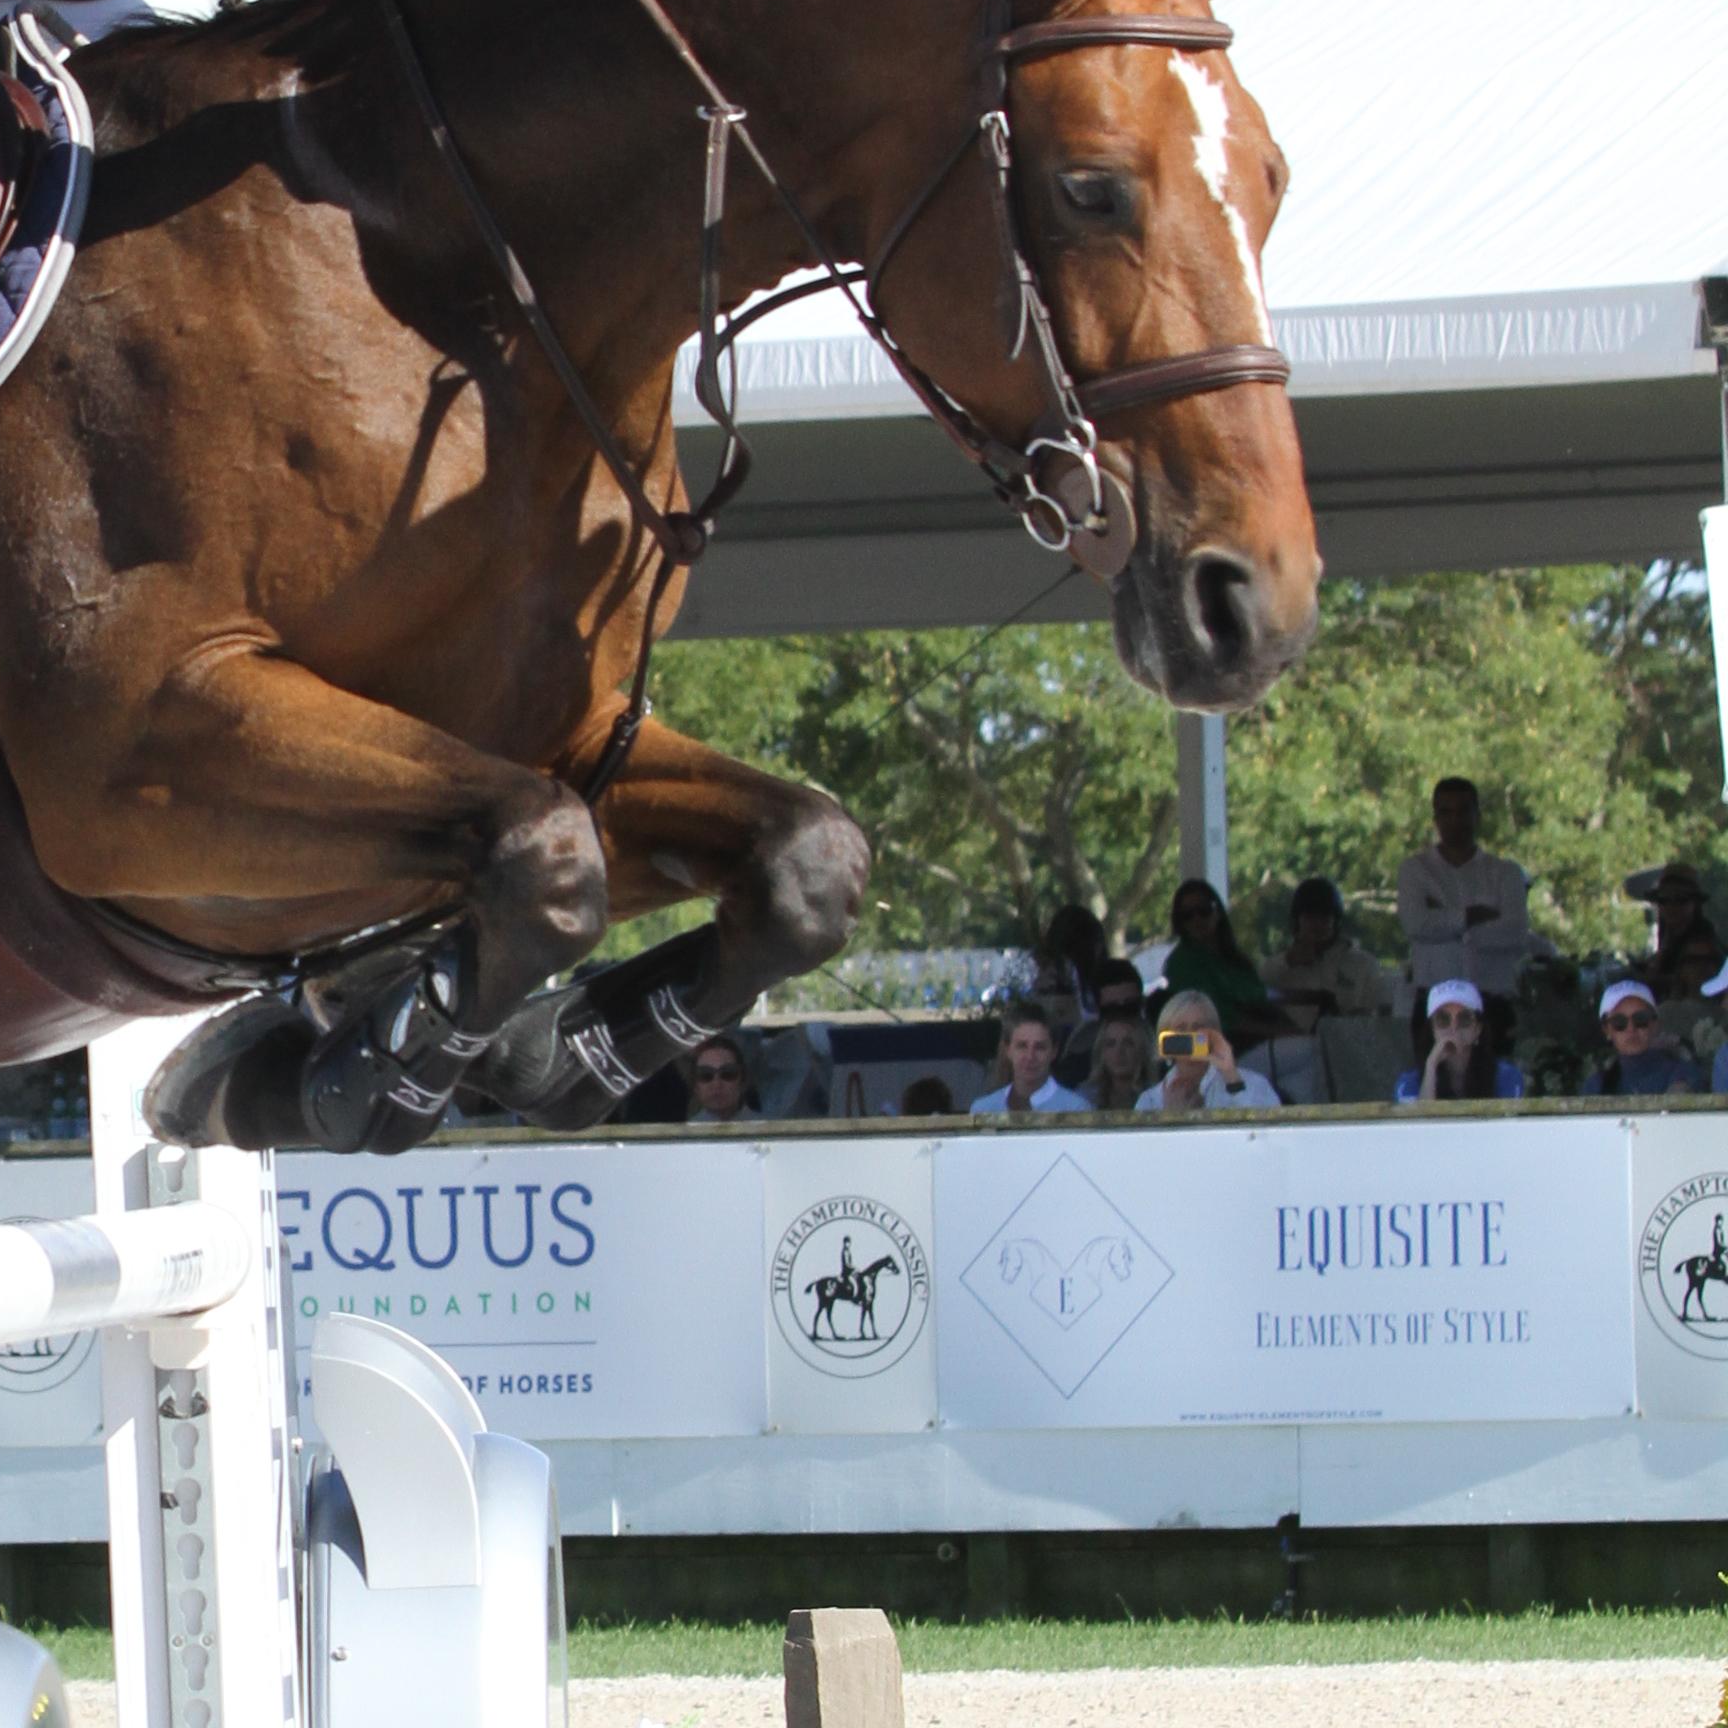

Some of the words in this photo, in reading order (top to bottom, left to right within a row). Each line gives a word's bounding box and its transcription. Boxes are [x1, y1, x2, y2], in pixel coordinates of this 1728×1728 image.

[276, 1182, 595, 1271] EQUUS
[774, 1251, 790, 1295] THE
[787, 1198, 876, 1251] HAMPTON
[879, 1210, 928, 1296] CLASSIC
[1275, 1200, 1508, 1276] EQUISITE
[1642, 1232, 1661, 1275] THE
[300, 1292, 592, 1318] OUNDATION
[1059, 1277, 1075, 1314] E
[499, 1373, 592, 1394] HORSES
